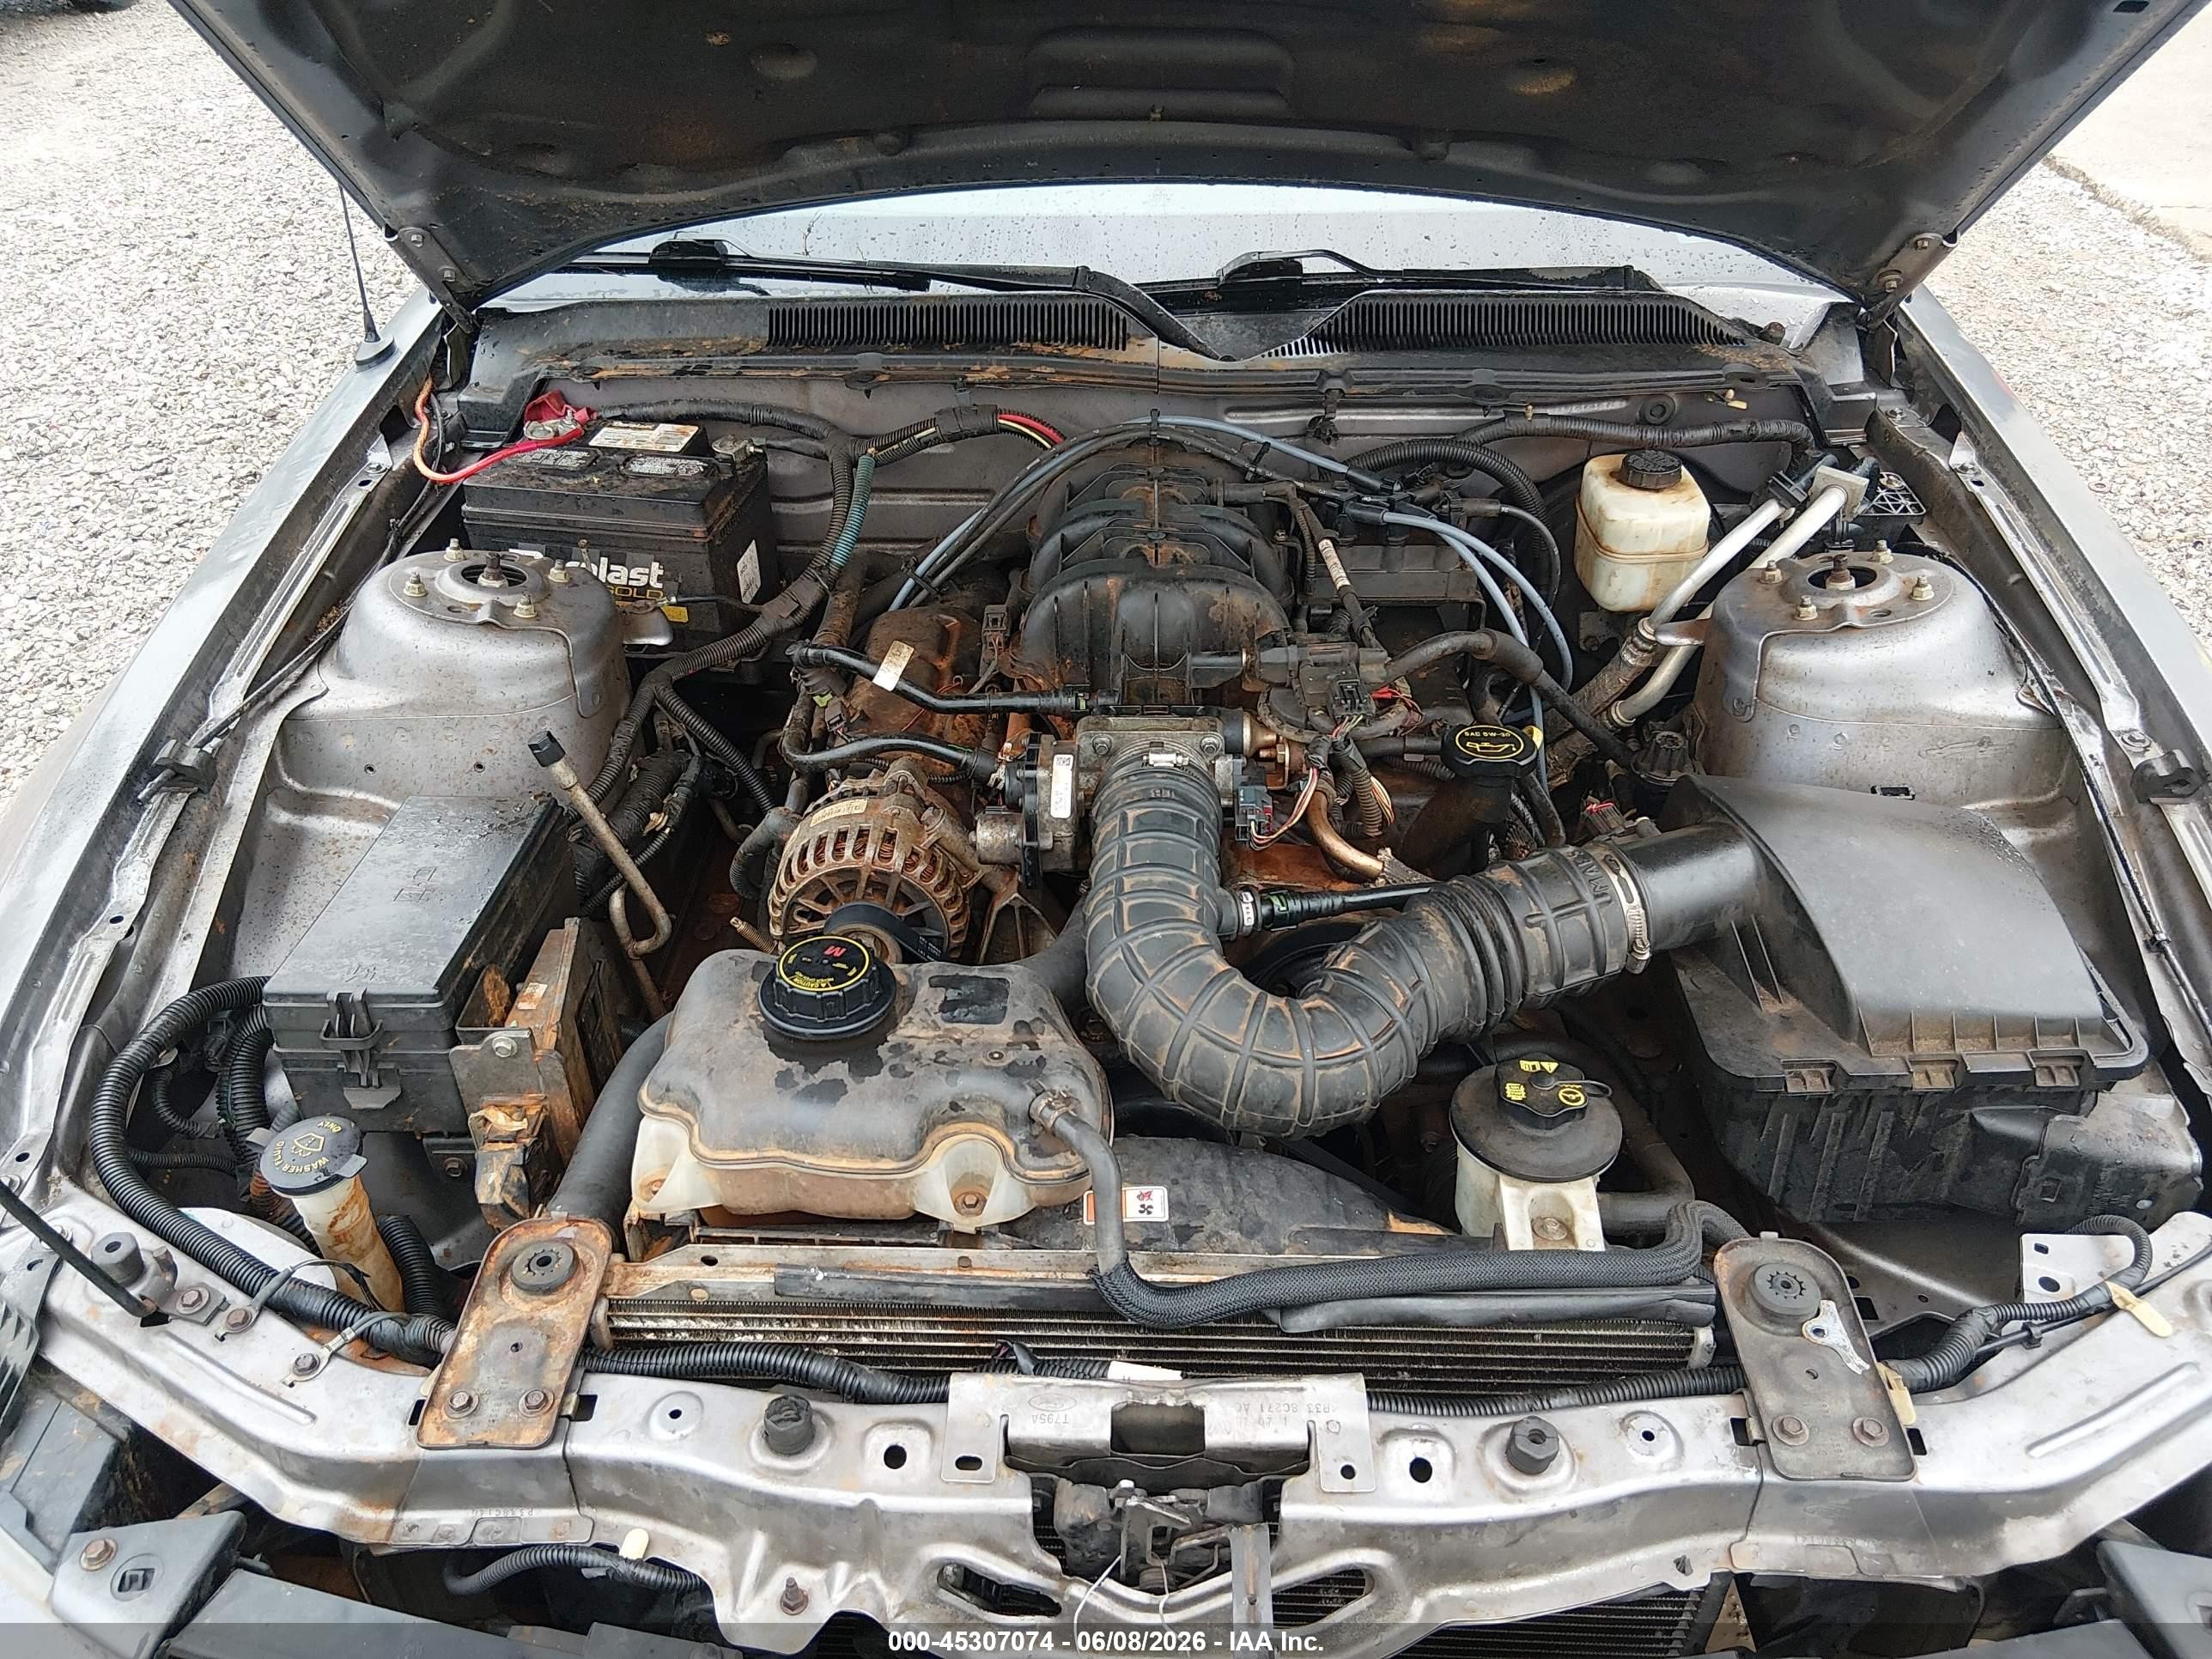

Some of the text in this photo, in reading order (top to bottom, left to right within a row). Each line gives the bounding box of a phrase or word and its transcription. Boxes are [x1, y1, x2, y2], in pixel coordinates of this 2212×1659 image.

[317, 1120, 343, 1133] ONLY
[274, 1140, 330, 1174] WASHER FLUID
[1031, 1413, 1069, 1425] T795A
